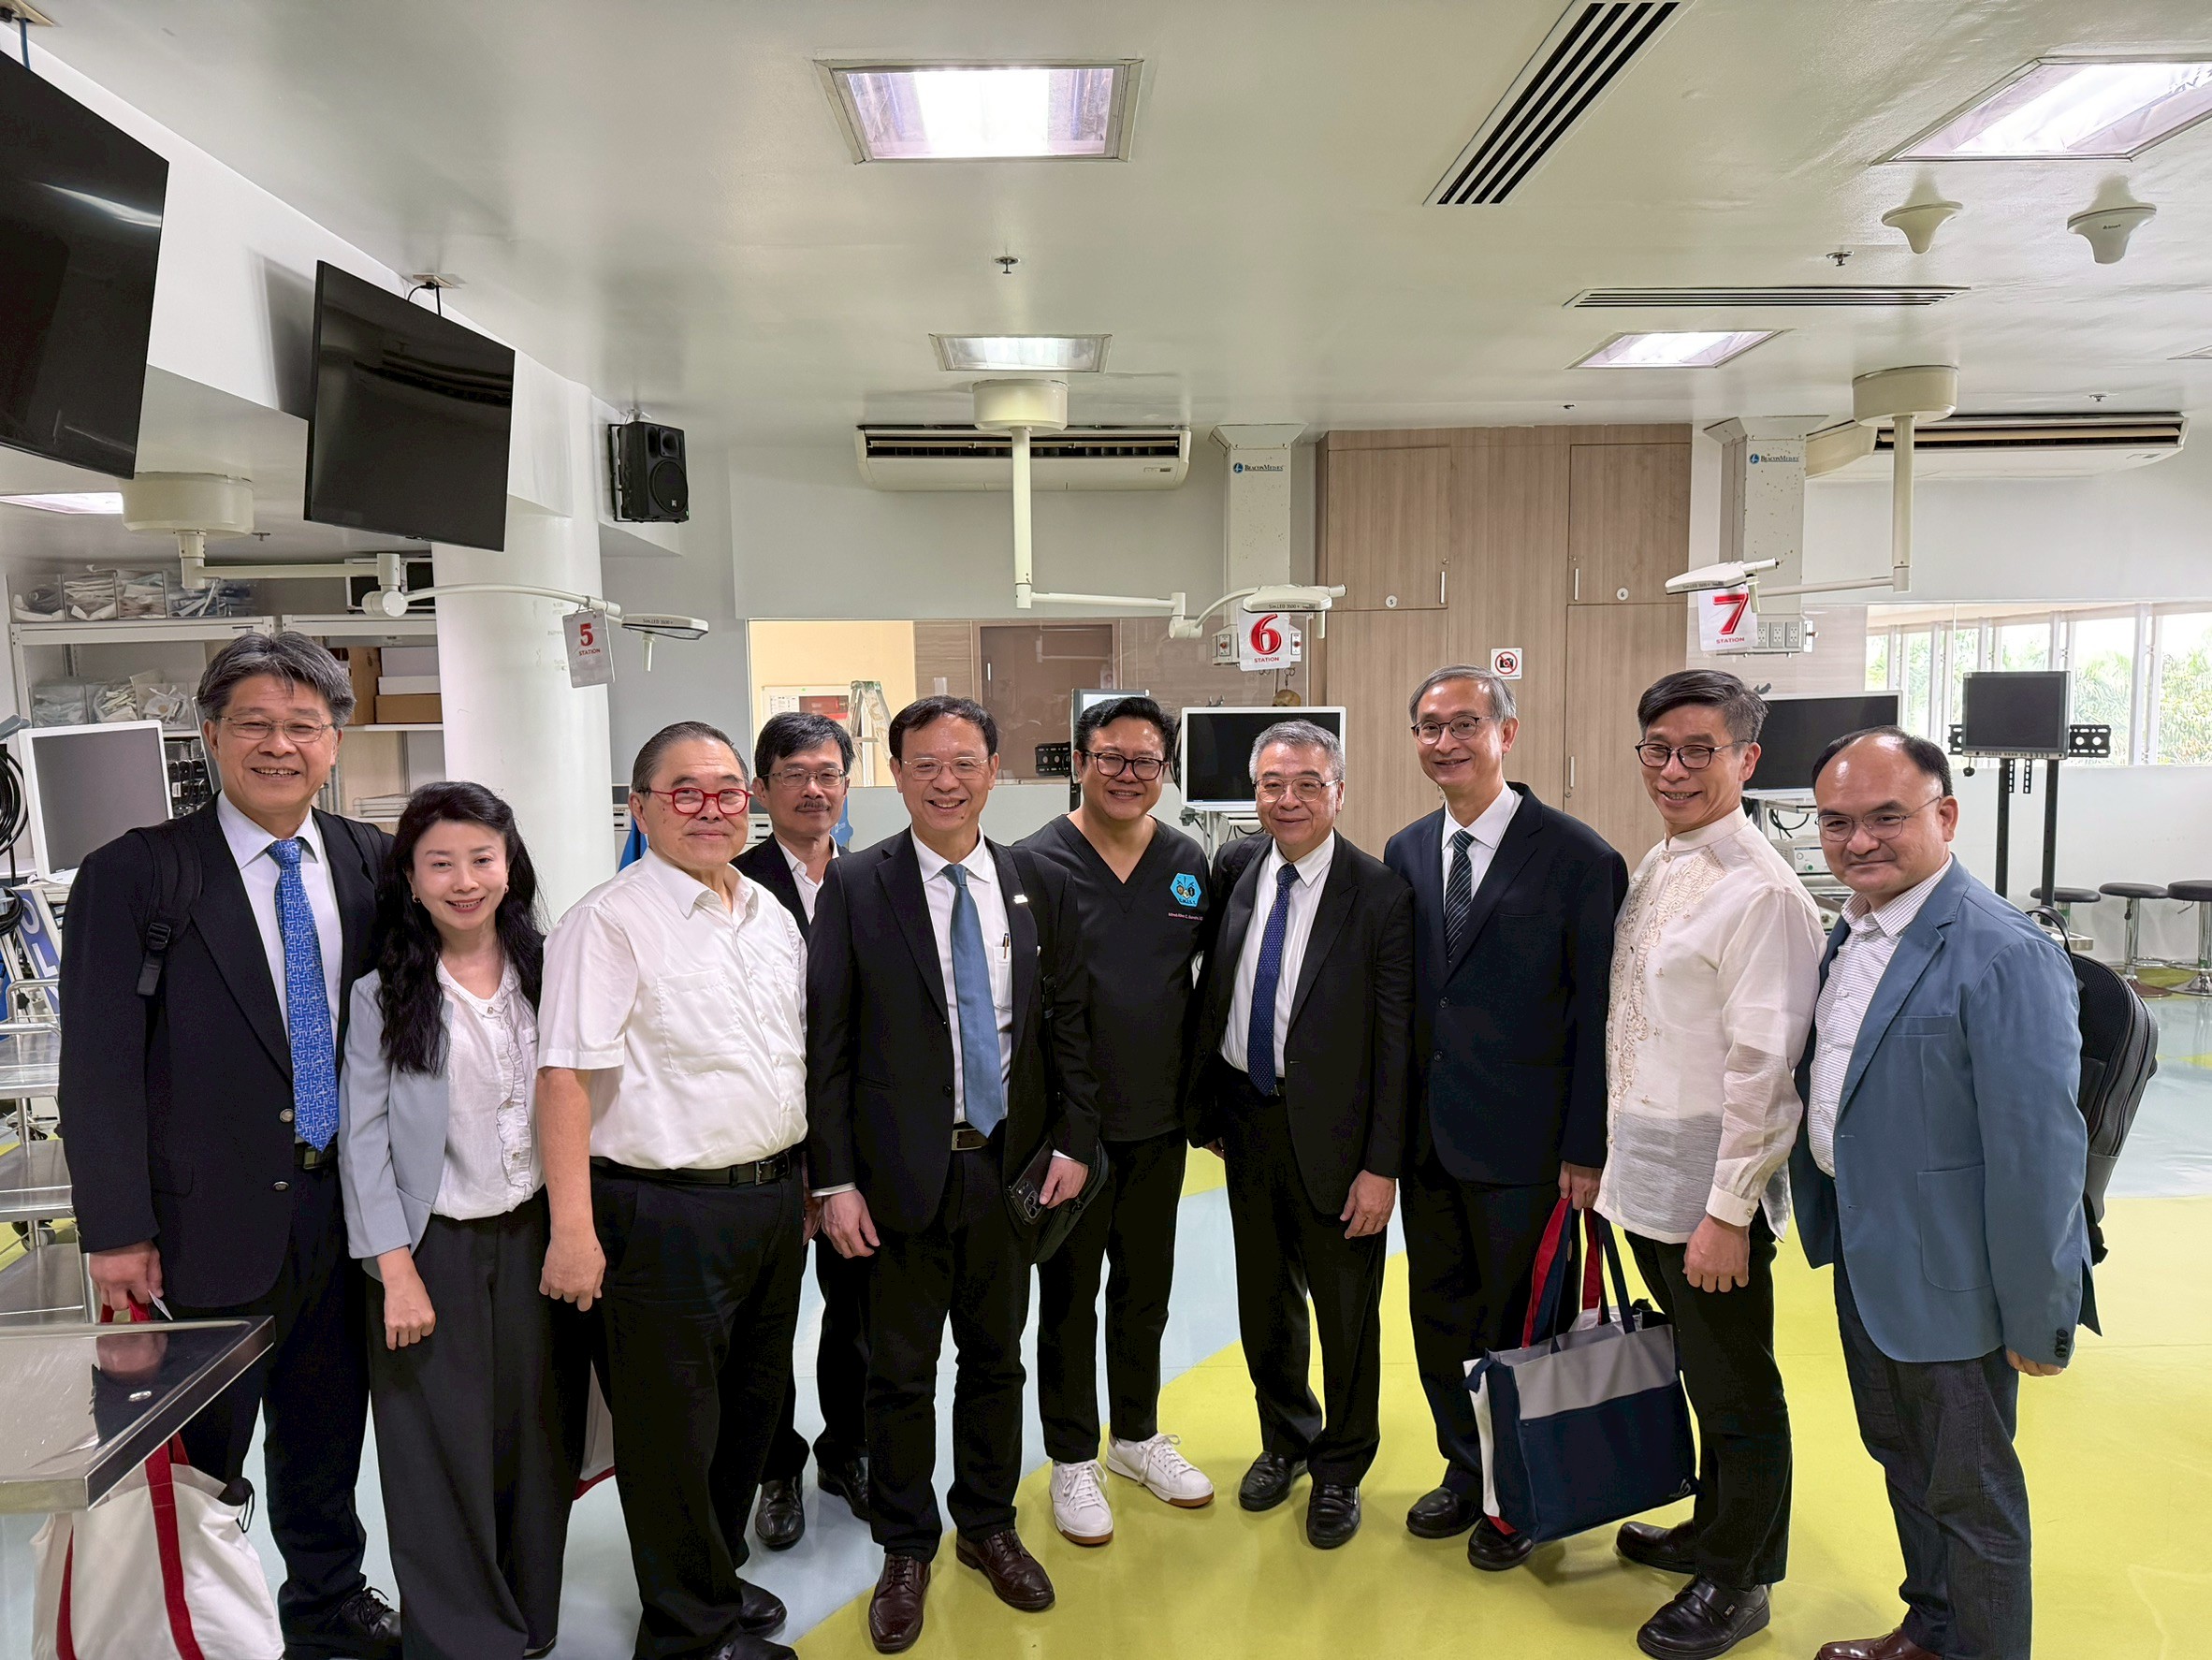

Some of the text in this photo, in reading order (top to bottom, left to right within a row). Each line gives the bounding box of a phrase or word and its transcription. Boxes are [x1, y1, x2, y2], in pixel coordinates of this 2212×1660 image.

[1712, 592, 1749, 634] 7
[579, 622, 594, 647] 5
[1250, 613, 1282, 655] 6
[578, 648, 601, 656] STATION
